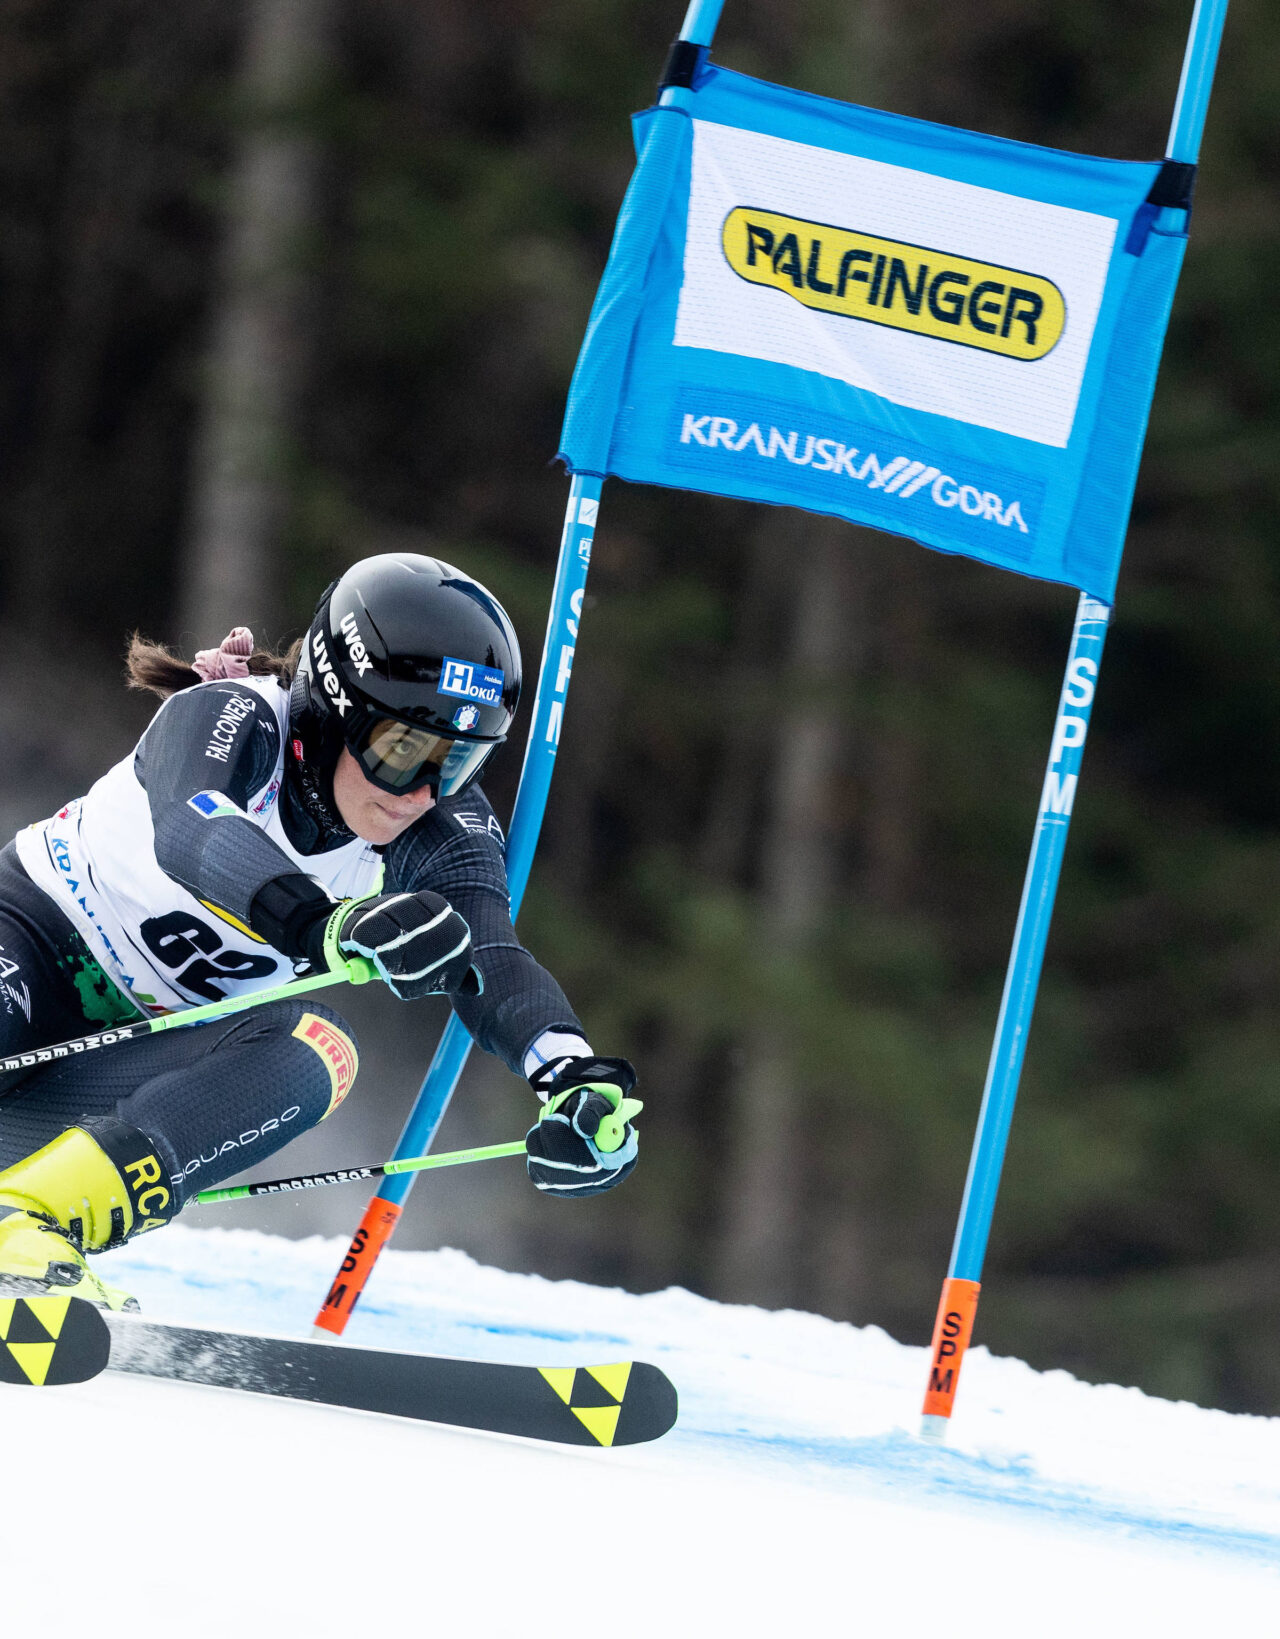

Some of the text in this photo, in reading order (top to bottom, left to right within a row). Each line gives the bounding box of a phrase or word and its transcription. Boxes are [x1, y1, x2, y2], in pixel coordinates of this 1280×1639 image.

[746, 221, 1044, 346] PALFINGER
[680, 413, 1029, 533] KRANJSKA GORA
[312, 629, 353, 718] uvex
[340, 611, 374, 678] uvex
[1040, 657, 1098, 816] SPM
[140, 911, 278, 1001] 62
[324, 1229, 369, 1309] SPM
[929, 1311, 962, 1393] SPM
